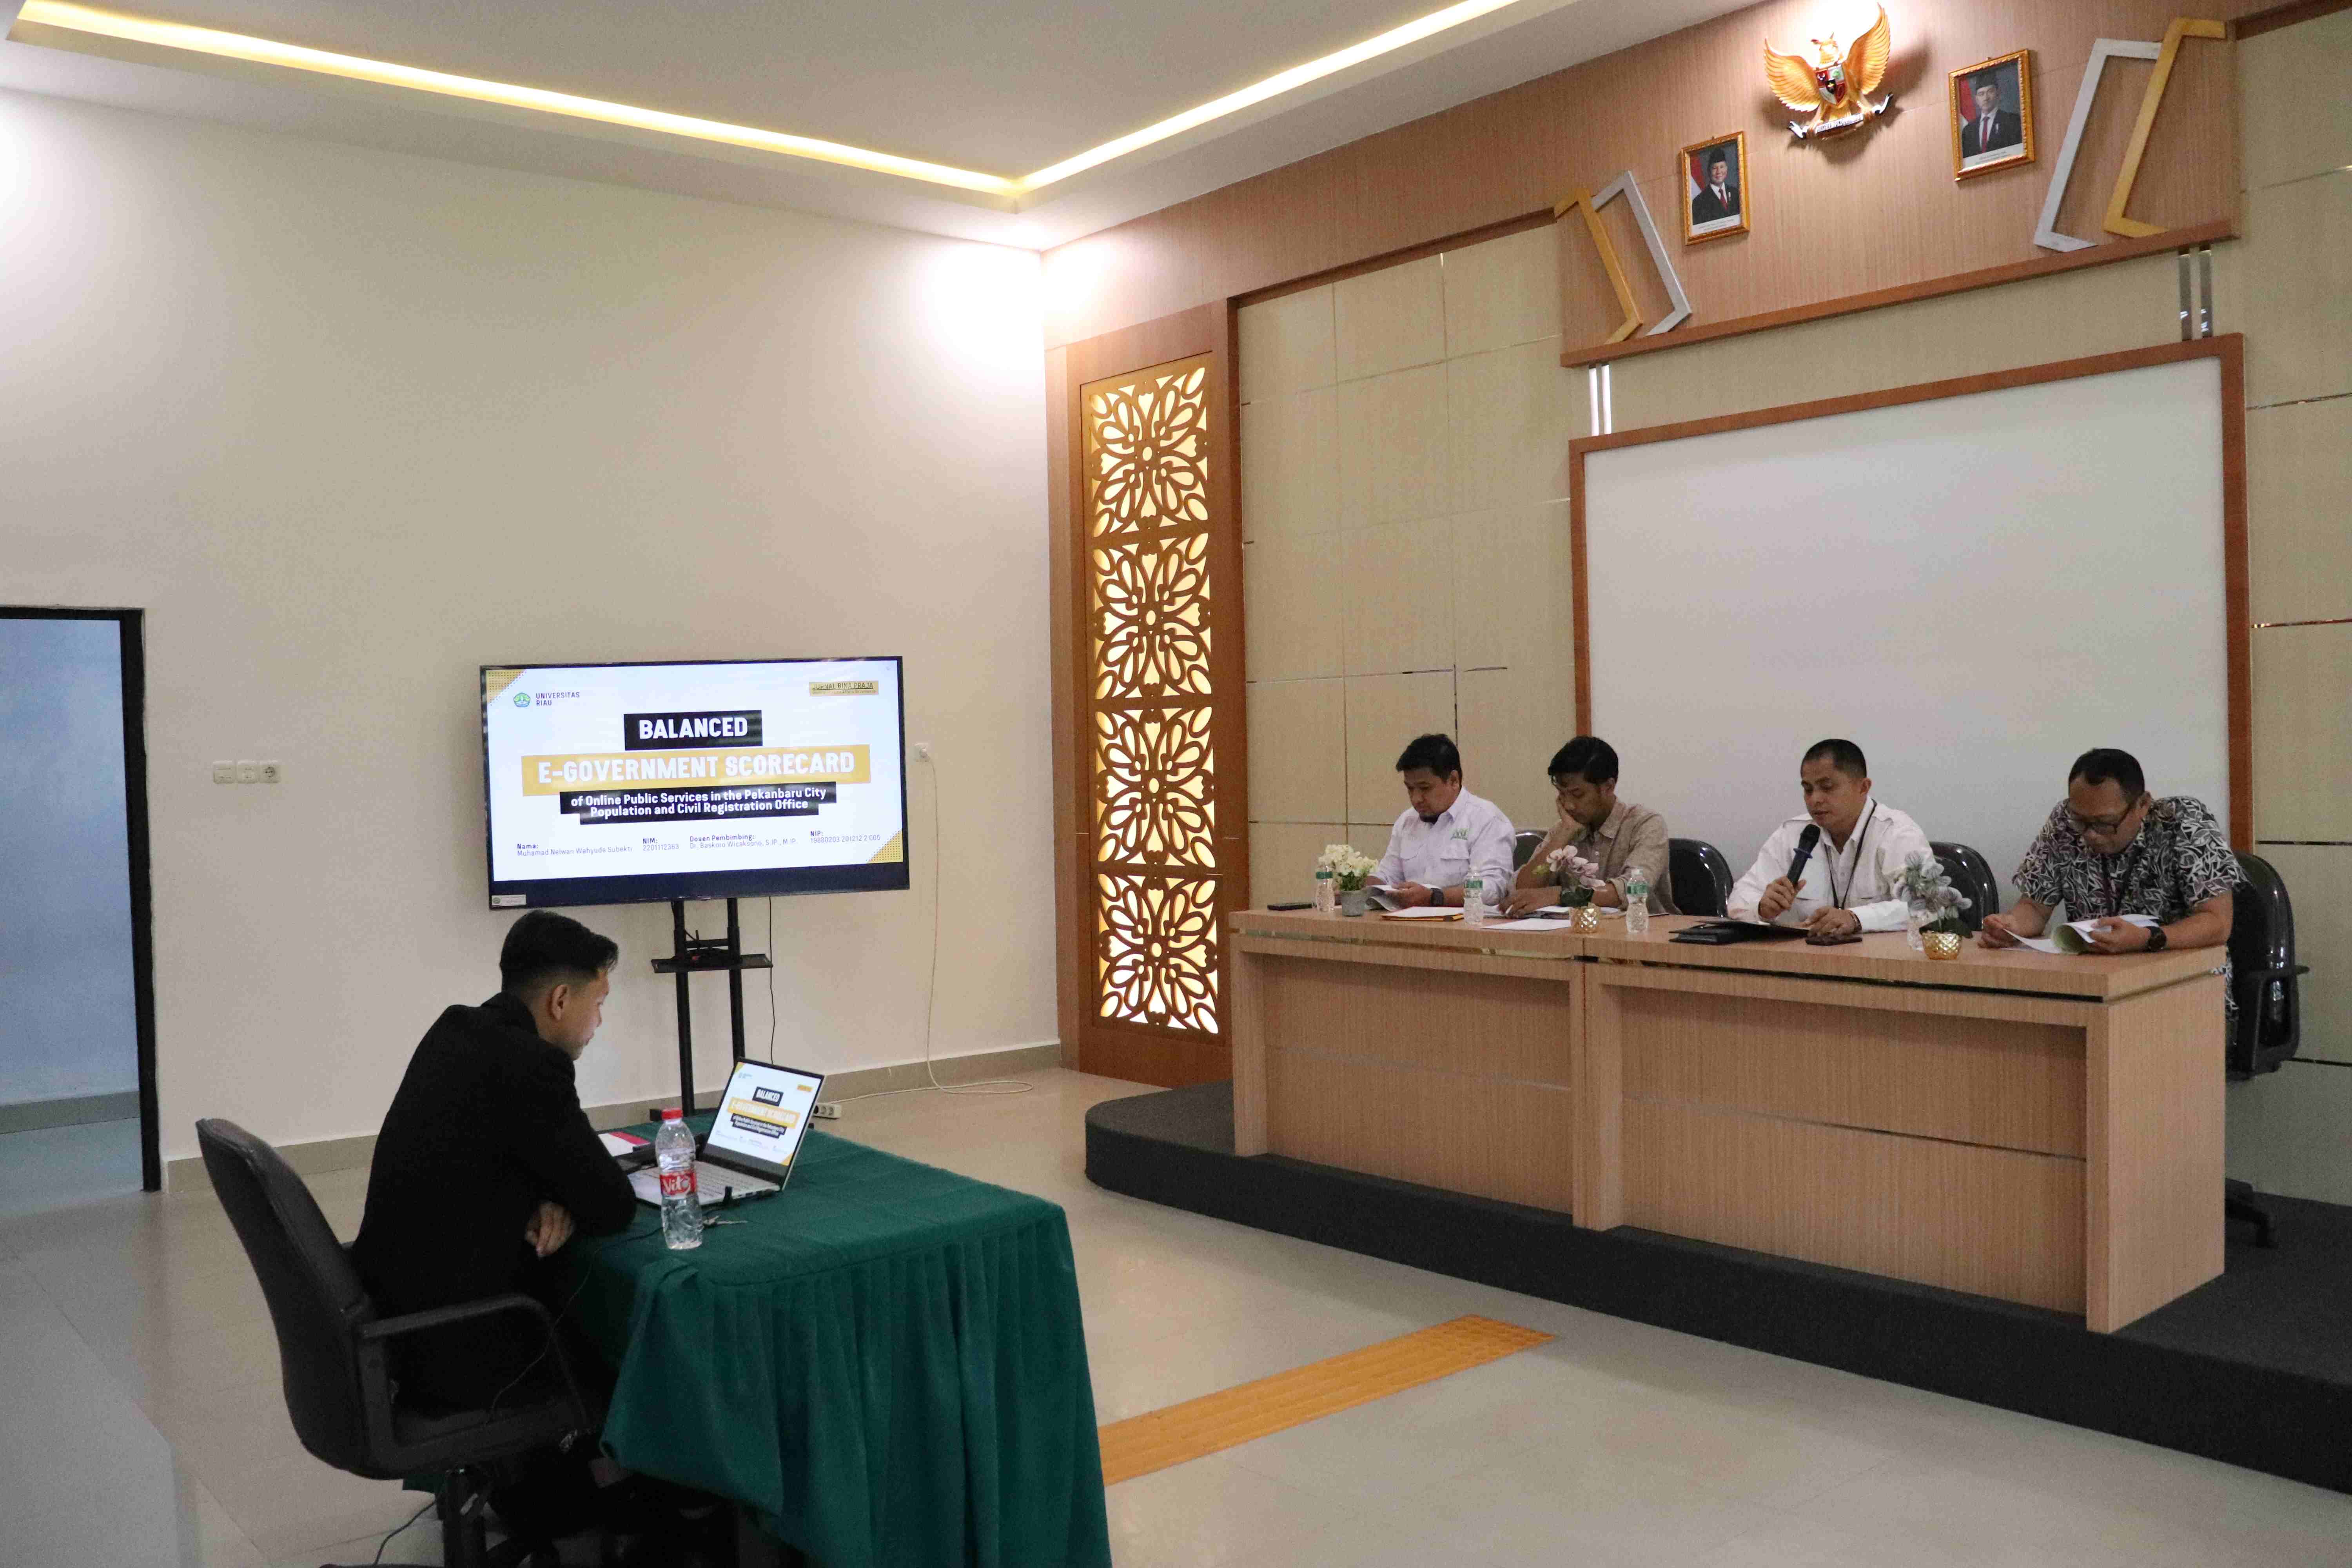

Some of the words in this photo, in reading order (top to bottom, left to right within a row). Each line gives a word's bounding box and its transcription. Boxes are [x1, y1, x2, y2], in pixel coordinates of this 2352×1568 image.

[639, 717, 748, 739] BALANCED
[538, 755, 718, 783] E-GOVERNMENT
[726, 752, 855, 777] SCORECARD
[571, 795, 583, 806] of
[586, 795, 621, 806] Online
[624, 793, 659, 804] Public
[661, 791, 709, 803] Services
[711, 791, 721, 801] in
[724, 790, 742, 800] the
[745, 788, 802, 800] Pekanbaru
[805, 787, 826, 800] City
[591, 805, 652, 820] Population
[654, 804, 675, 814] and
[677, 802, 701, 813] Civil
[704, 800, 772, 815] Registration
[775, 799, 808, 810] Office
